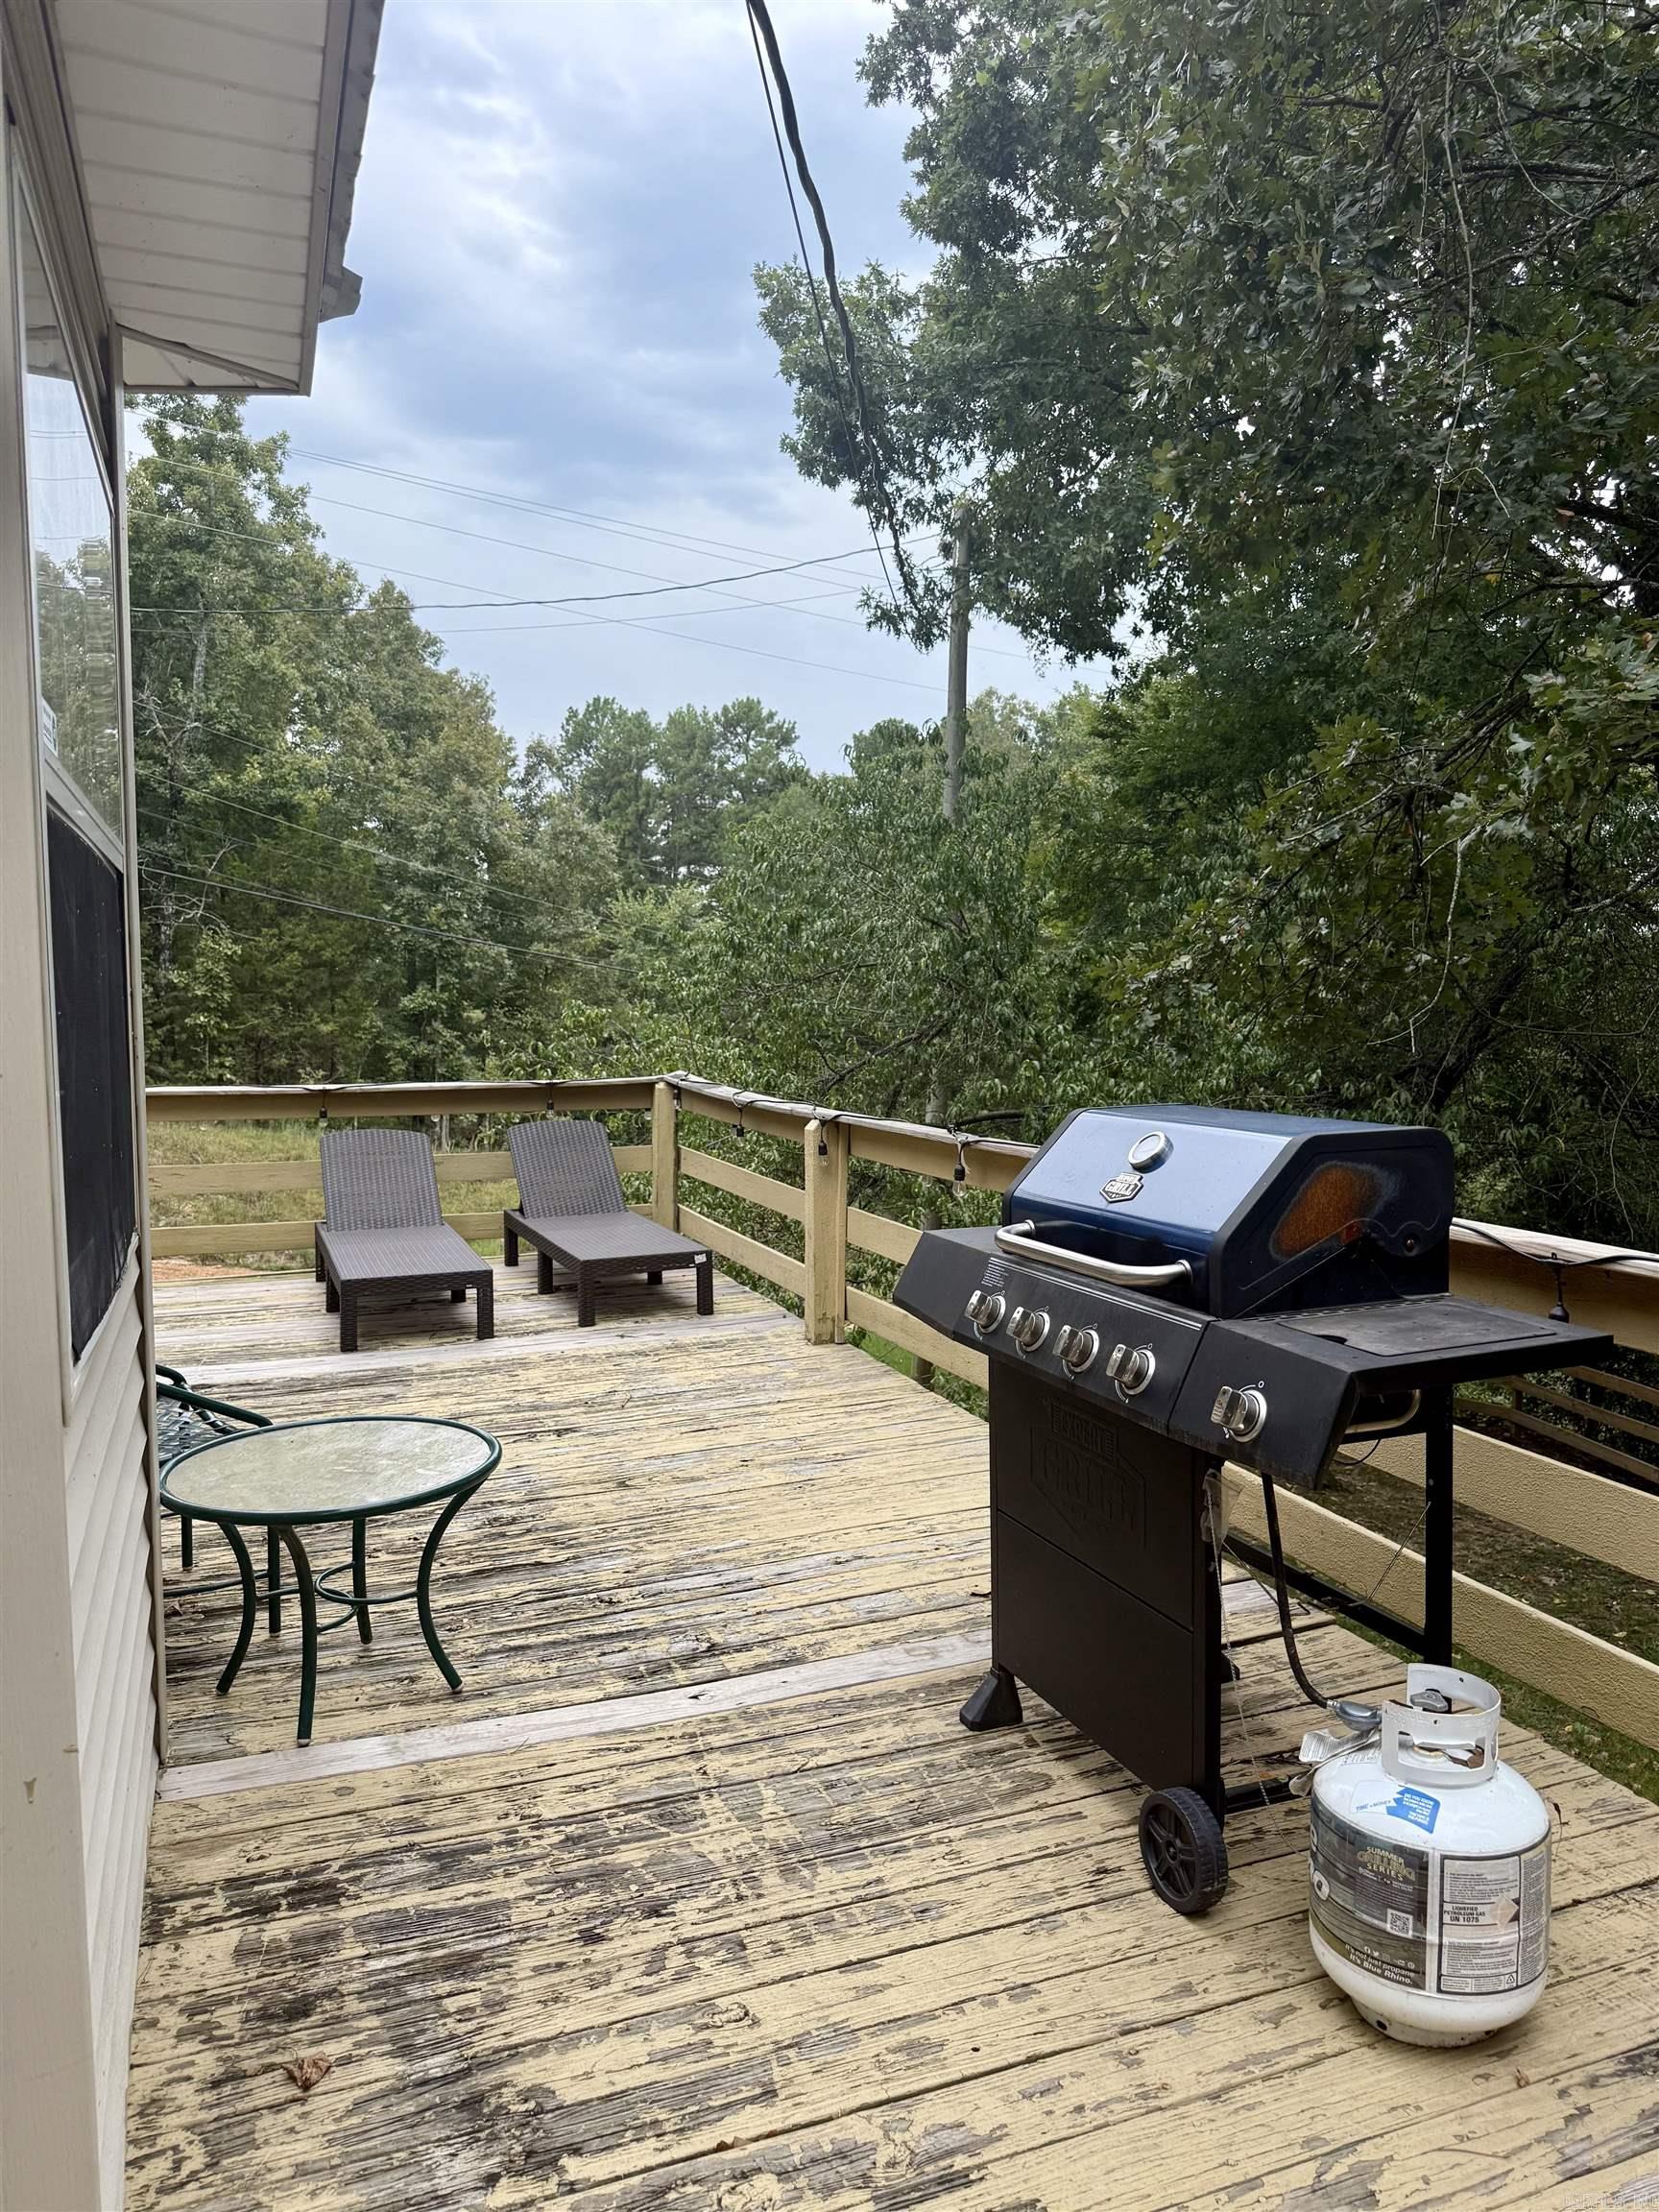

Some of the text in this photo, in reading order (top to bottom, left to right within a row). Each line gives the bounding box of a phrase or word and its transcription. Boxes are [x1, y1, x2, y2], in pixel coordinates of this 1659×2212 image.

[1105, 1181, 1135, 1195] GRILL
[1366, 1846, 1406, 1866] SUMMER
[1366, 1863, 1403, 1881] SERIES
[1356, 1950, 1367, 1960] not
[1367, 1958, 1382, 1967] just
[1382, 1963, 1415, 1978] propane
[1363, 1960, 1382, 1974] Blue
[1384, 1970, 1413, 1984] Rhino.
